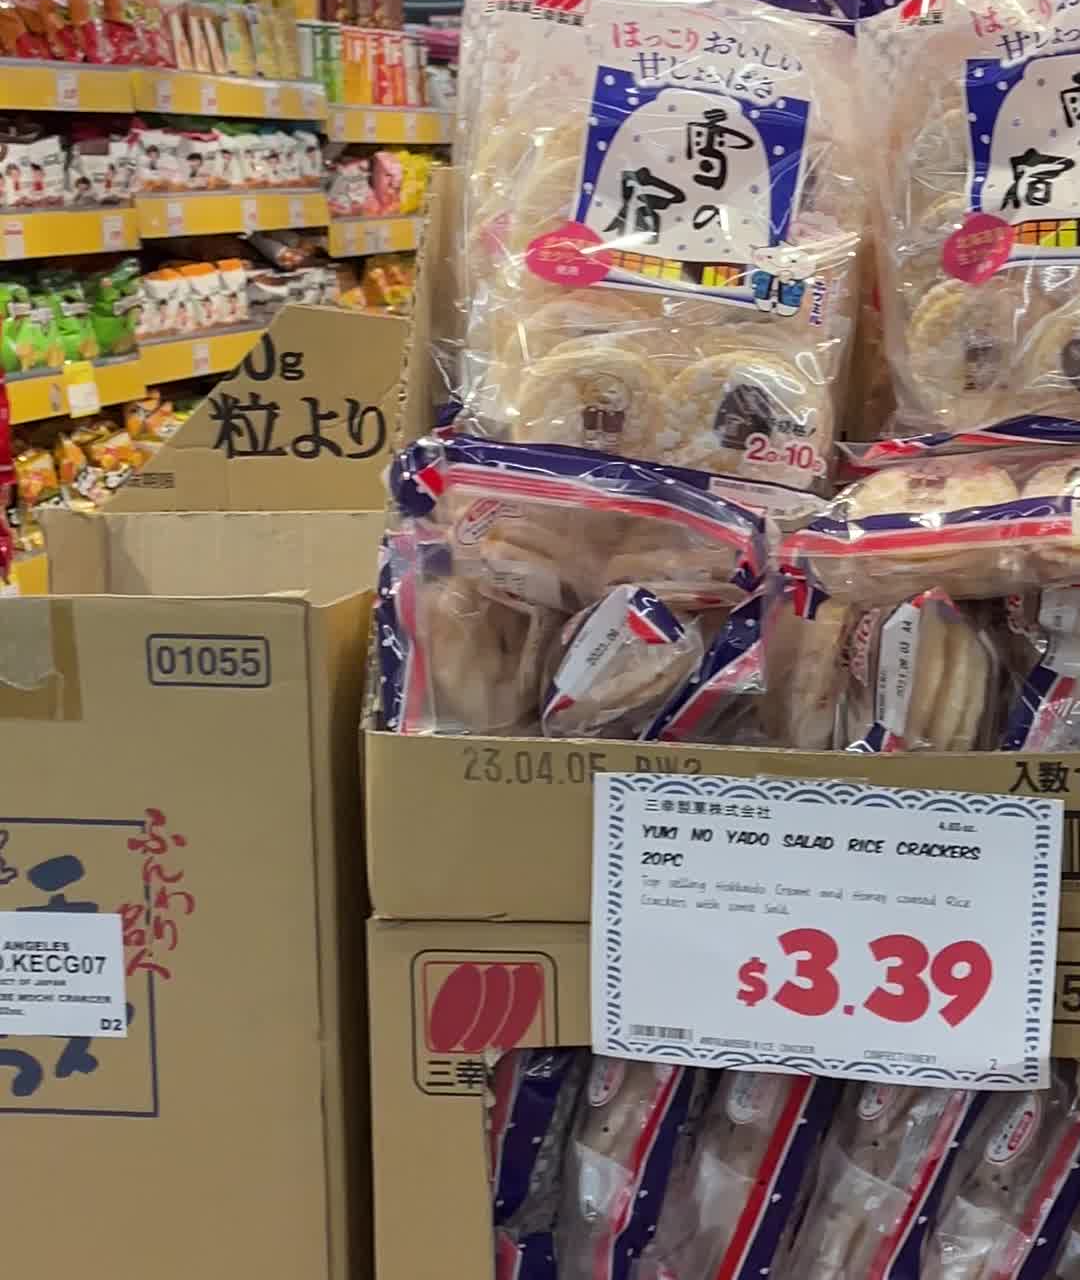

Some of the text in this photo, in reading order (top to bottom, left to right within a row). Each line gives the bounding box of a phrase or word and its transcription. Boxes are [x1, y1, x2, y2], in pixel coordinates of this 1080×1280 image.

[222, 331, 306, 383] 0g
[208, 391, 388, 460] 粒より
[156, 645, 261, 677] 01055
[642, 824, 981, 860] YUKI NO YADO SALAD RICE CRACKERS
[641, 851, 684, 867] 20PC
[3, 940, 70, 952] ANGELES
[0, 954, 107, 975] .KECG07
[736, 927, 994, 1029] $3.39
[100, 1017, 123, 1031] D2
